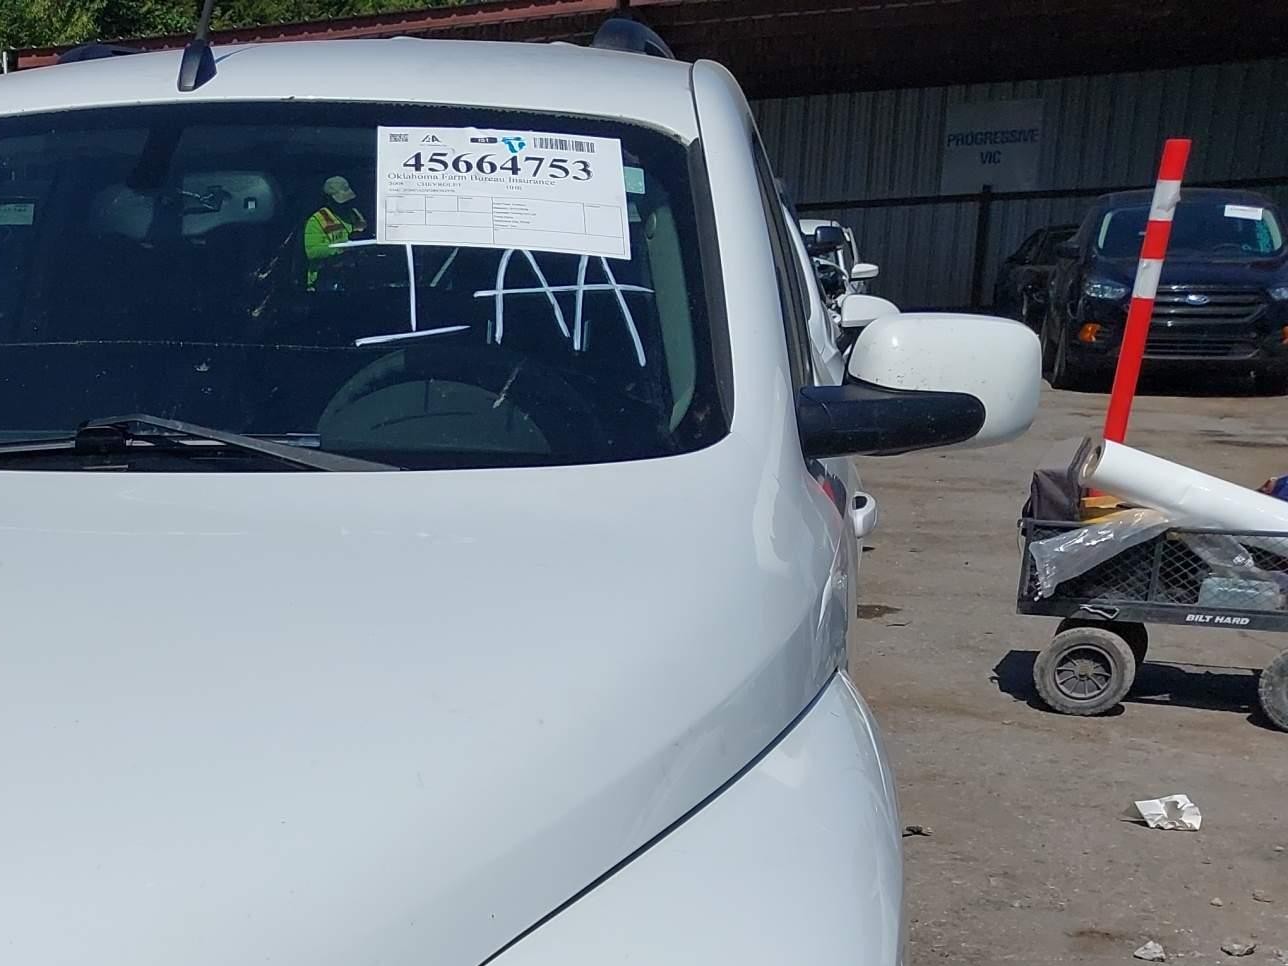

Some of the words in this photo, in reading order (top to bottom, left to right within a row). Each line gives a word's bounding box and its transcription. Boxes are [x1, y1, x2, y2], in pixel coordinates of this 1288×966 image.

[947, 129, 1038, 147] PROGRESSIVE
[981, 151, 1001, 164] VIC
[402, 151, 593, 181] 45664753
[387, 172, 439, 180] Oklahoma
[1186, 614, 1213, 623] BILT
[1214, 615, 1250, 625] HARD
